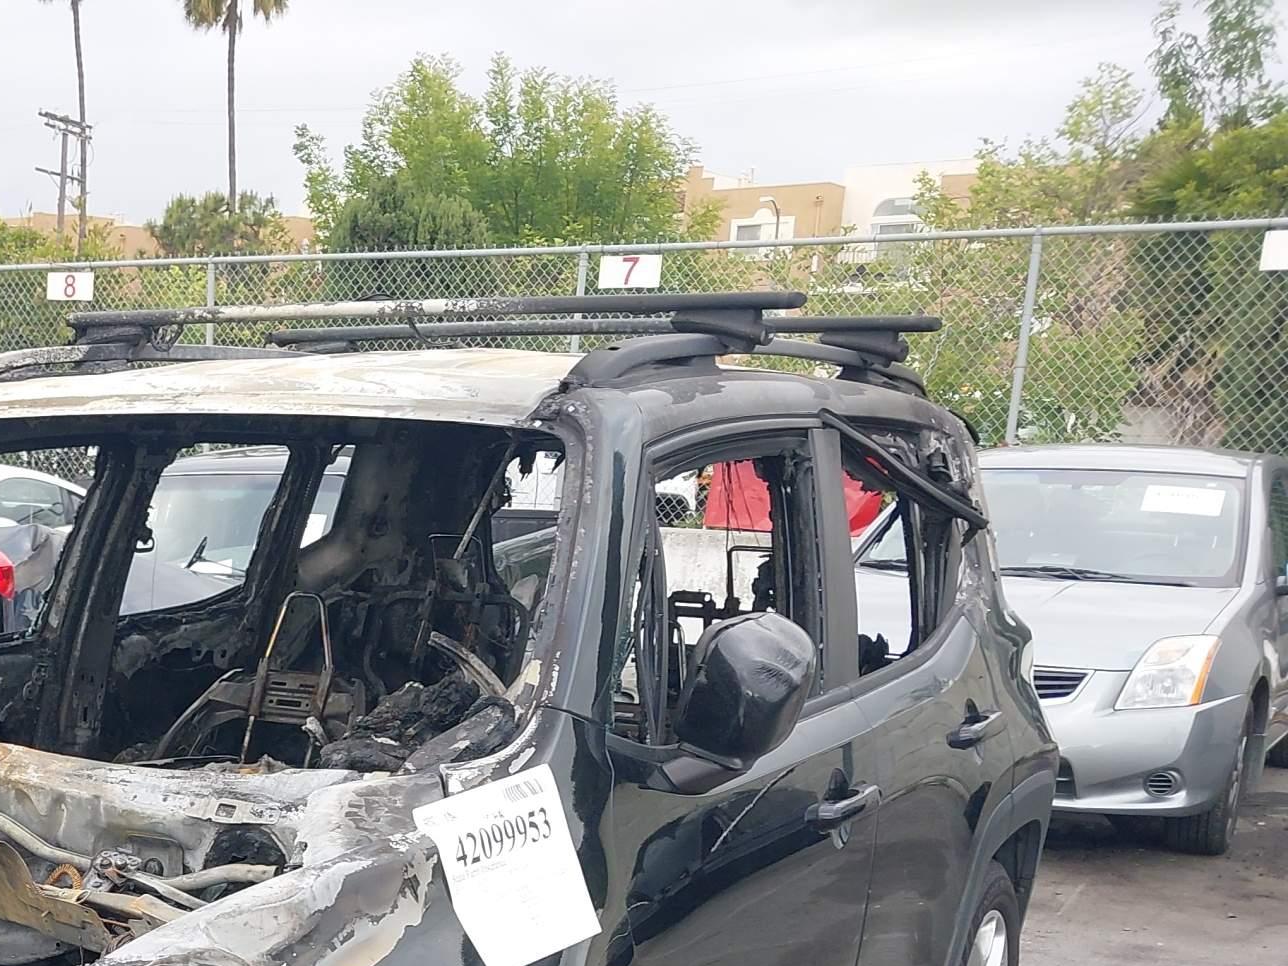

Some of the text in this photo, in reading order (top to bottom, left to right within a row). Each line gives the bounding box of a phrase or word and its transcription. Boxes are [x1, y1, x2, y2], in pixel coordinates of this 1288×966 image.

[622, 256, 640, 285] 7
[64, 274, 75, 298] 8
[455, 807, 552, 867] 42099953
